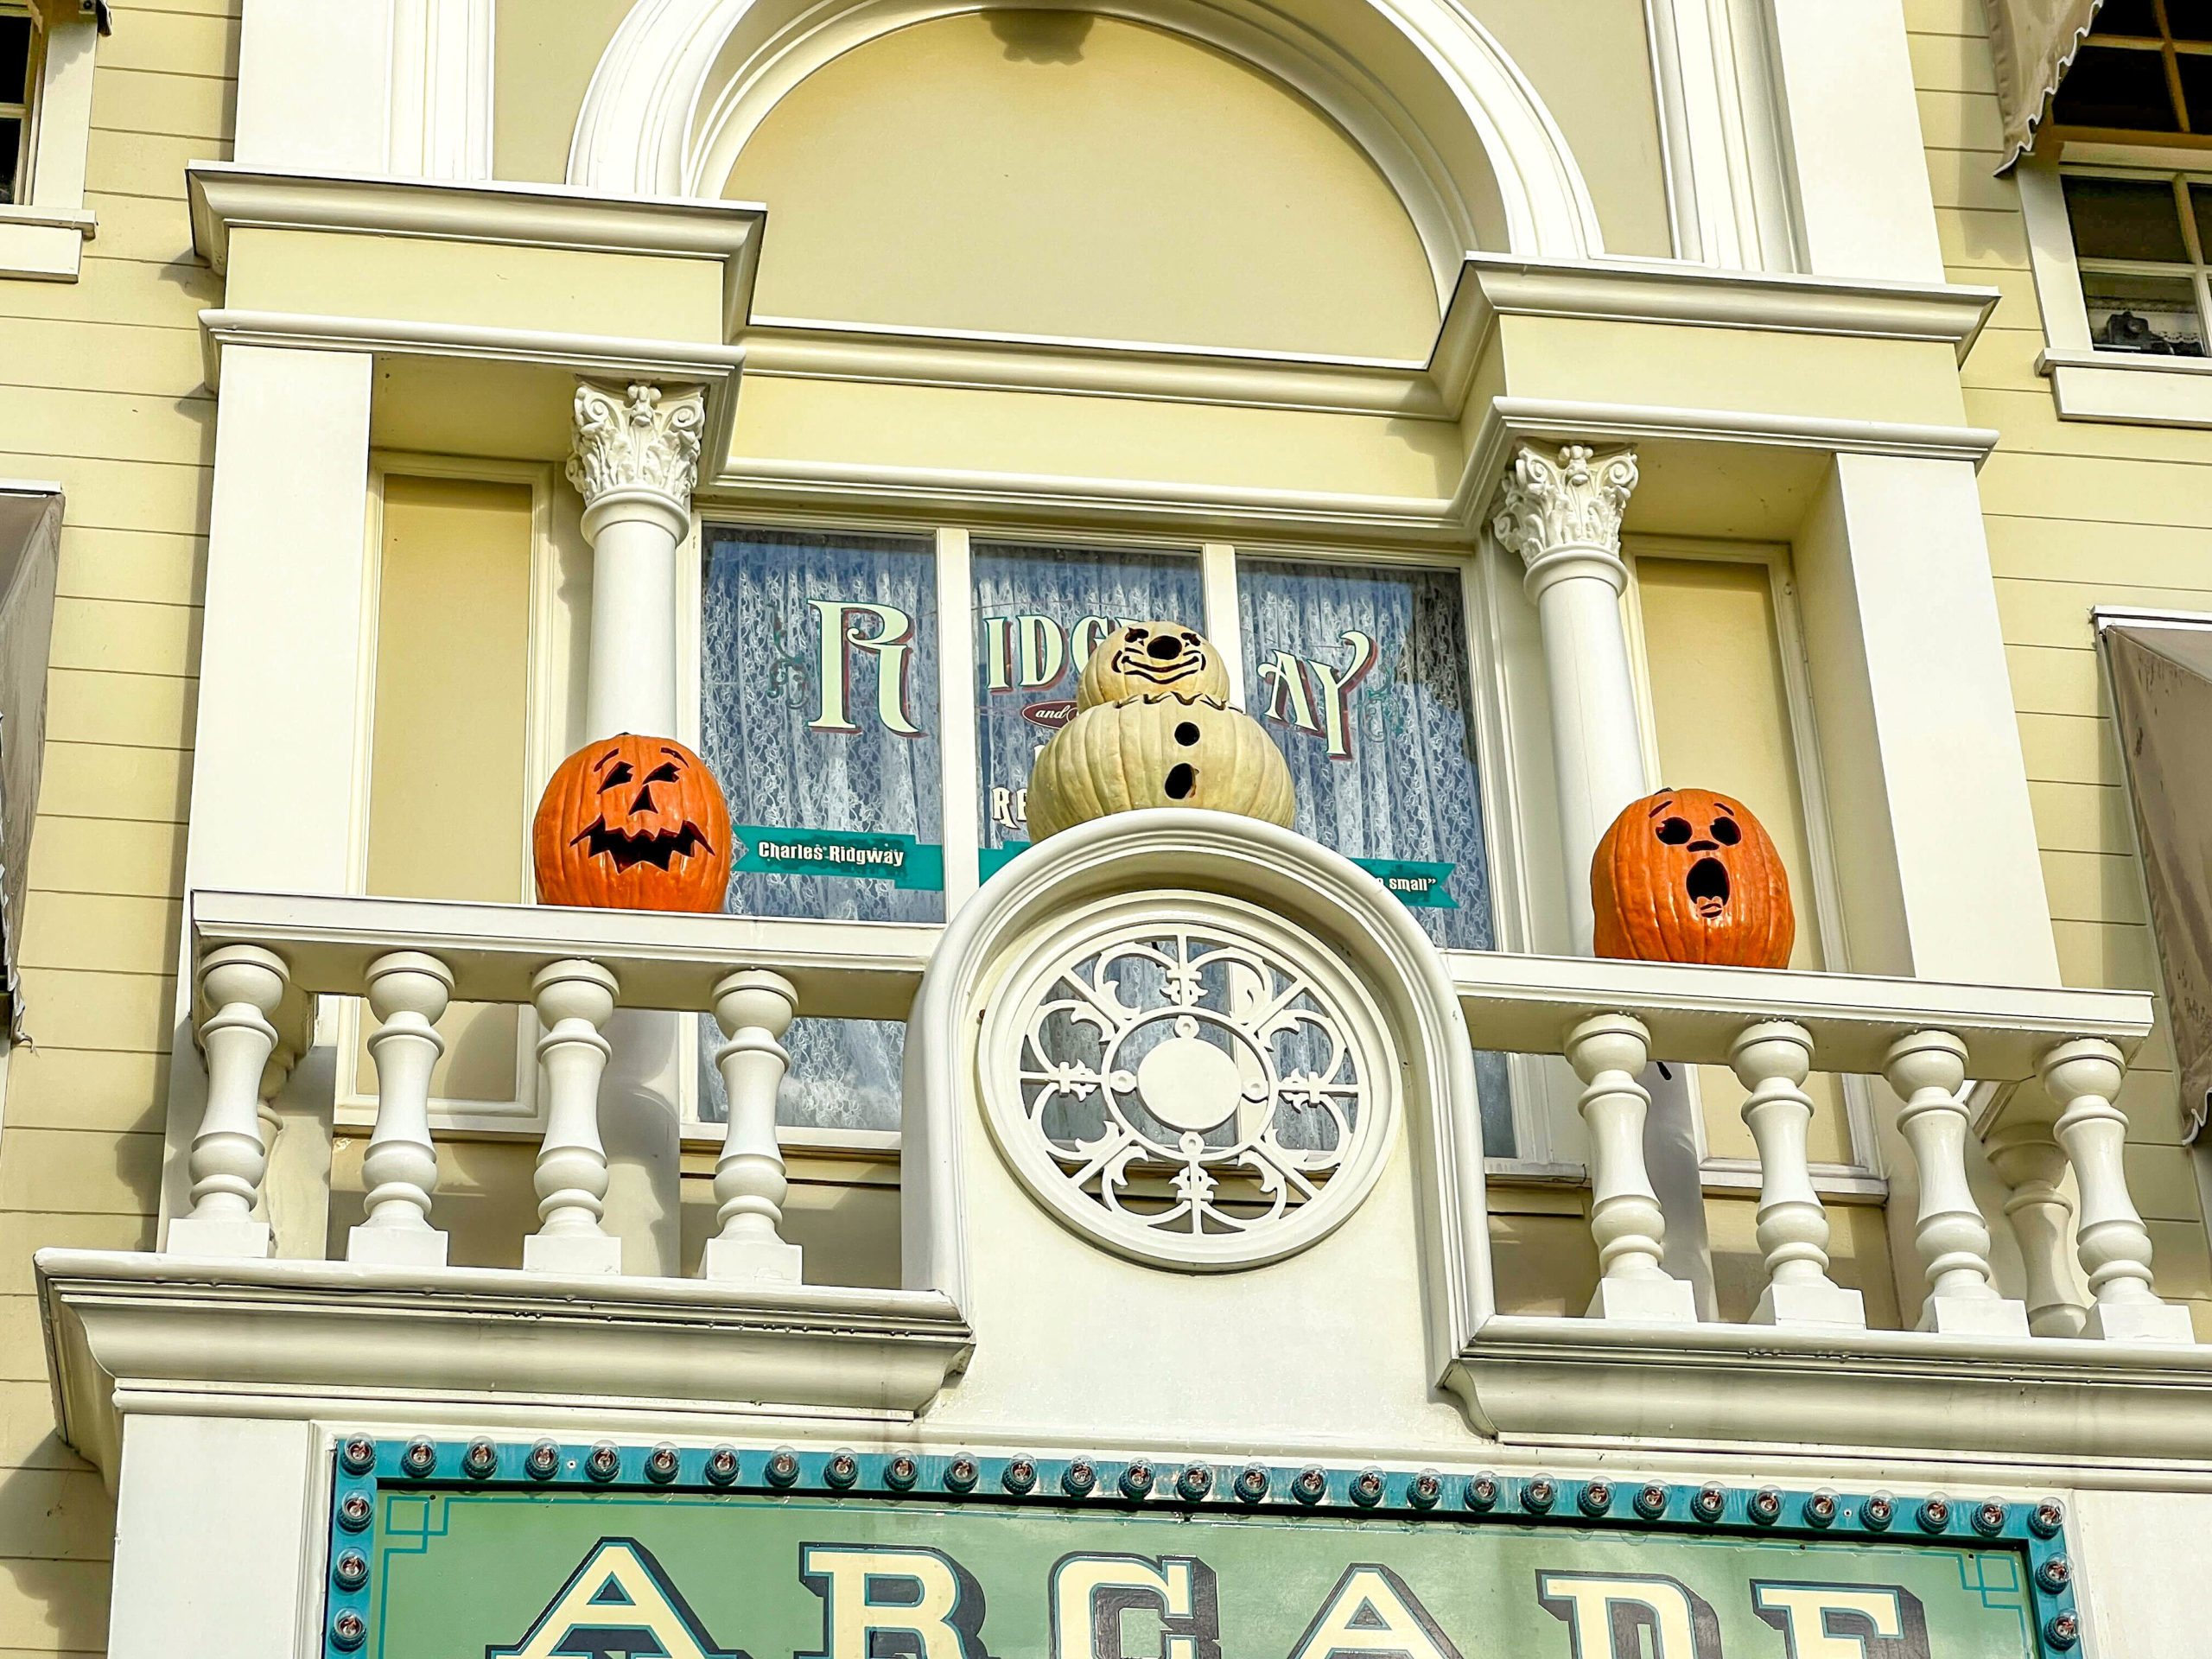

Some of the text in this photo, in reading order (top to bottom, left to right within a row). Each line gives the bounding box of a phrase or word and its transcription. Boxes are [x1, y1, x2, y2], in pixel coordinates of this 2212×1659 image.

[1035, 705, 1071, 719] and
[758, 841, 905, 868] Charles Ridgway
